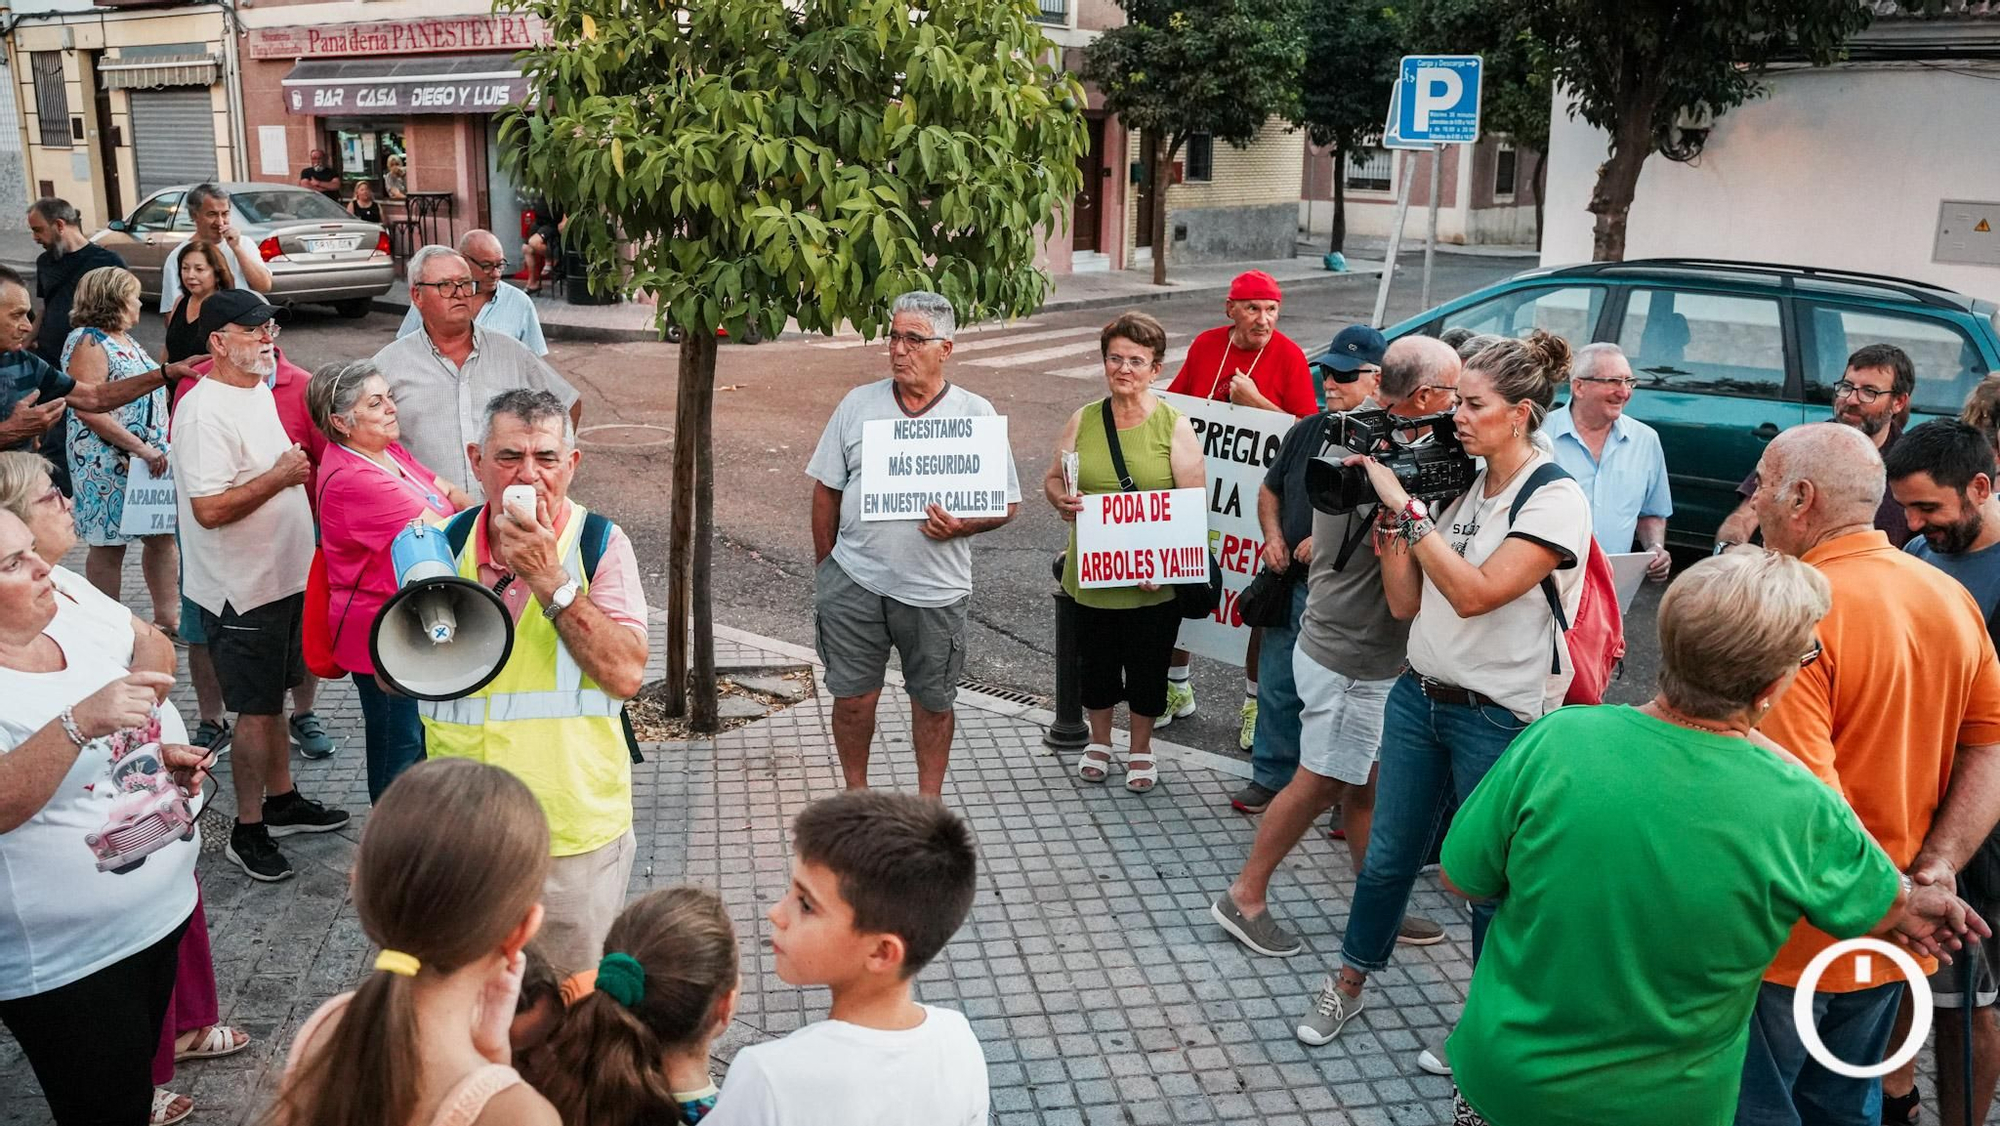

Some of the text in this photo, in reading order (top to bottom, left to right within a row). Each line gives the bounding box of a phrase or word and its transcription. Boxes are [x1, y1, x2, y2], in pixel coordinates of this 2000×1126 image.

[307, 25, 389, 53] Panadería
[391, 17, 531, 50] PANESTEYRA
[314, 85, 511, 107] BAR CASA DIEGO Y LUIS
[1414, 68, 1463, 131] P
[894, 418, 973, 440] NECESITAMOS
[888, 451, 980, 477] MÁS SEGURIDAD
[863, 493, 879, 514] EN
[882, 491, 943, 514] NUESTRAS
[945, 490, 988, 512] CALLES
[1102, 492, 1171, 525] PODA DE
[1211, 477, 1242, 518] LA
[151, 514, 165, 530] YA
[1081, 548, 1155, 582] ARBOLES
